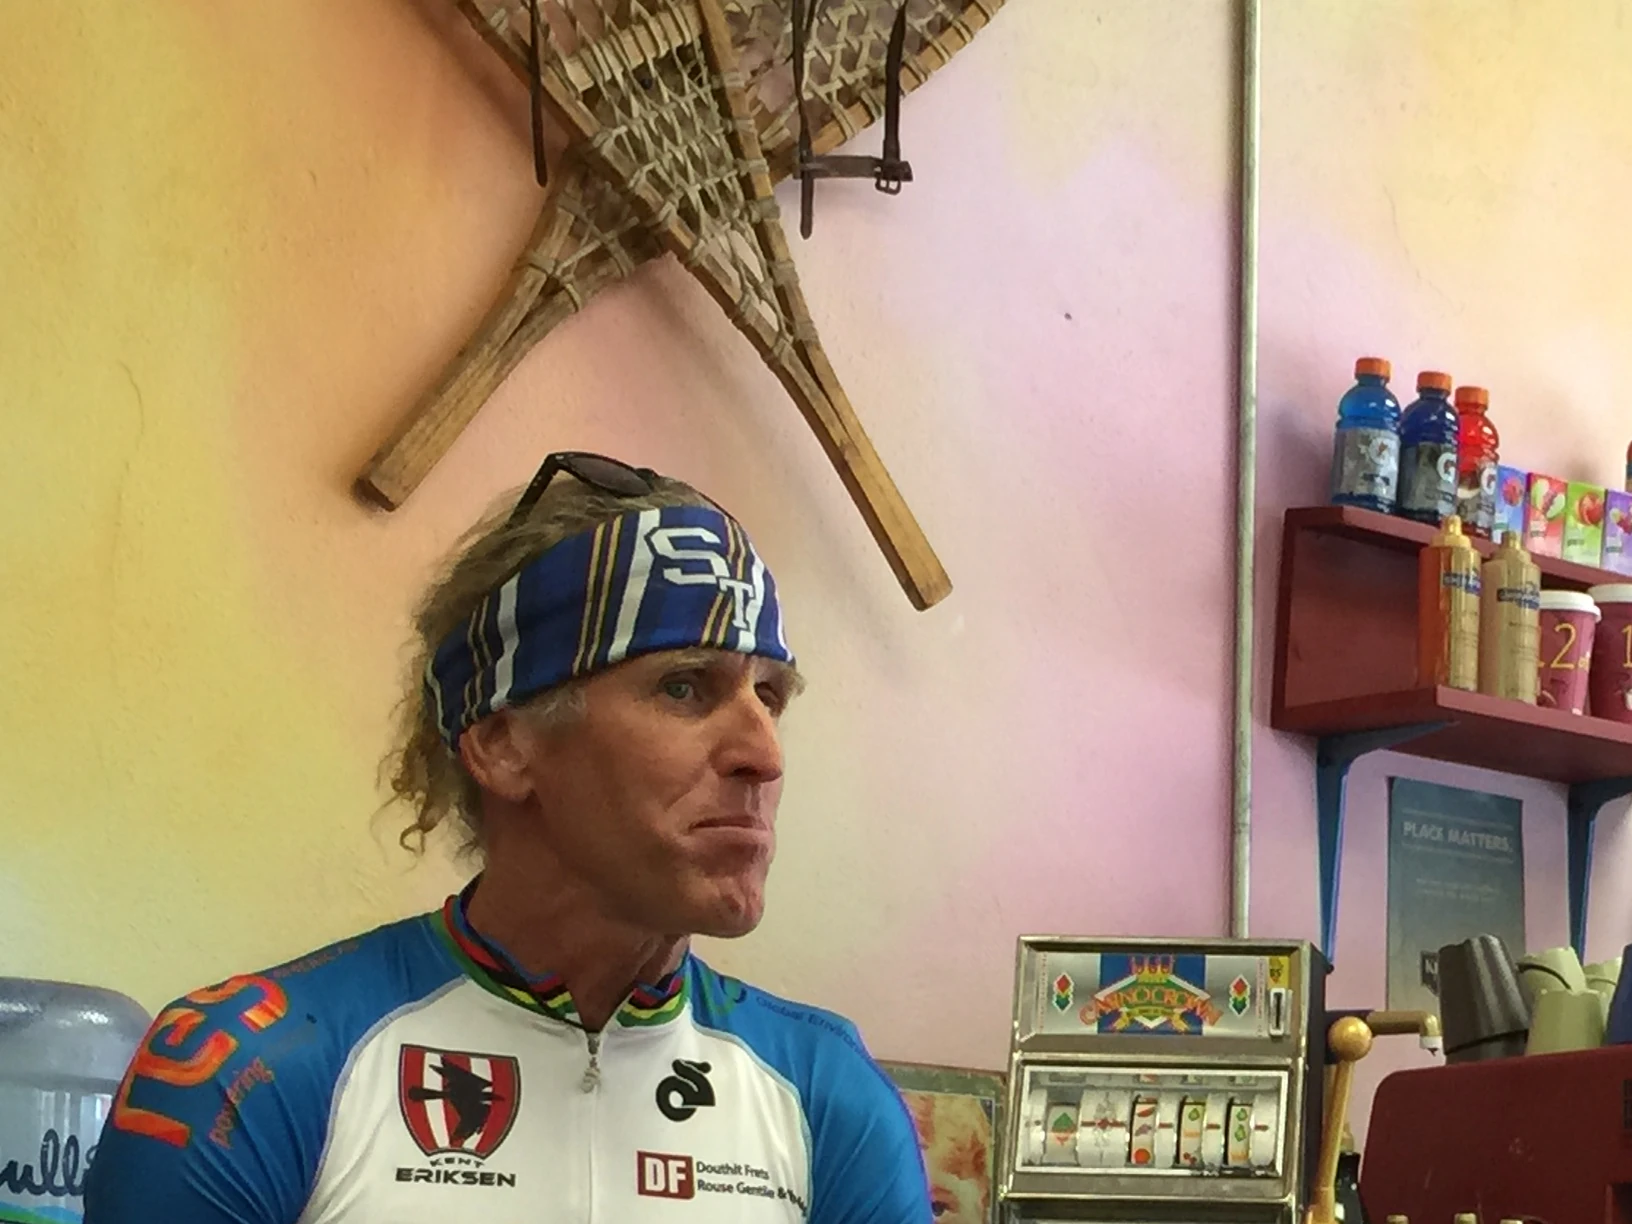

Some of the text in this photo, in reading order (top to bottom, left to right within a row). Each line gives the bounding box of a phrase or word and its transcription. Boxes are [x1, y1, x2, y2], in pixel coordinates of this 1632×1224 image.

[428, 1155, 485, 1169] KENT
[394, 1166, 517, 1189] ERIKSEN
[643, 1156, 690, 1195] DF
